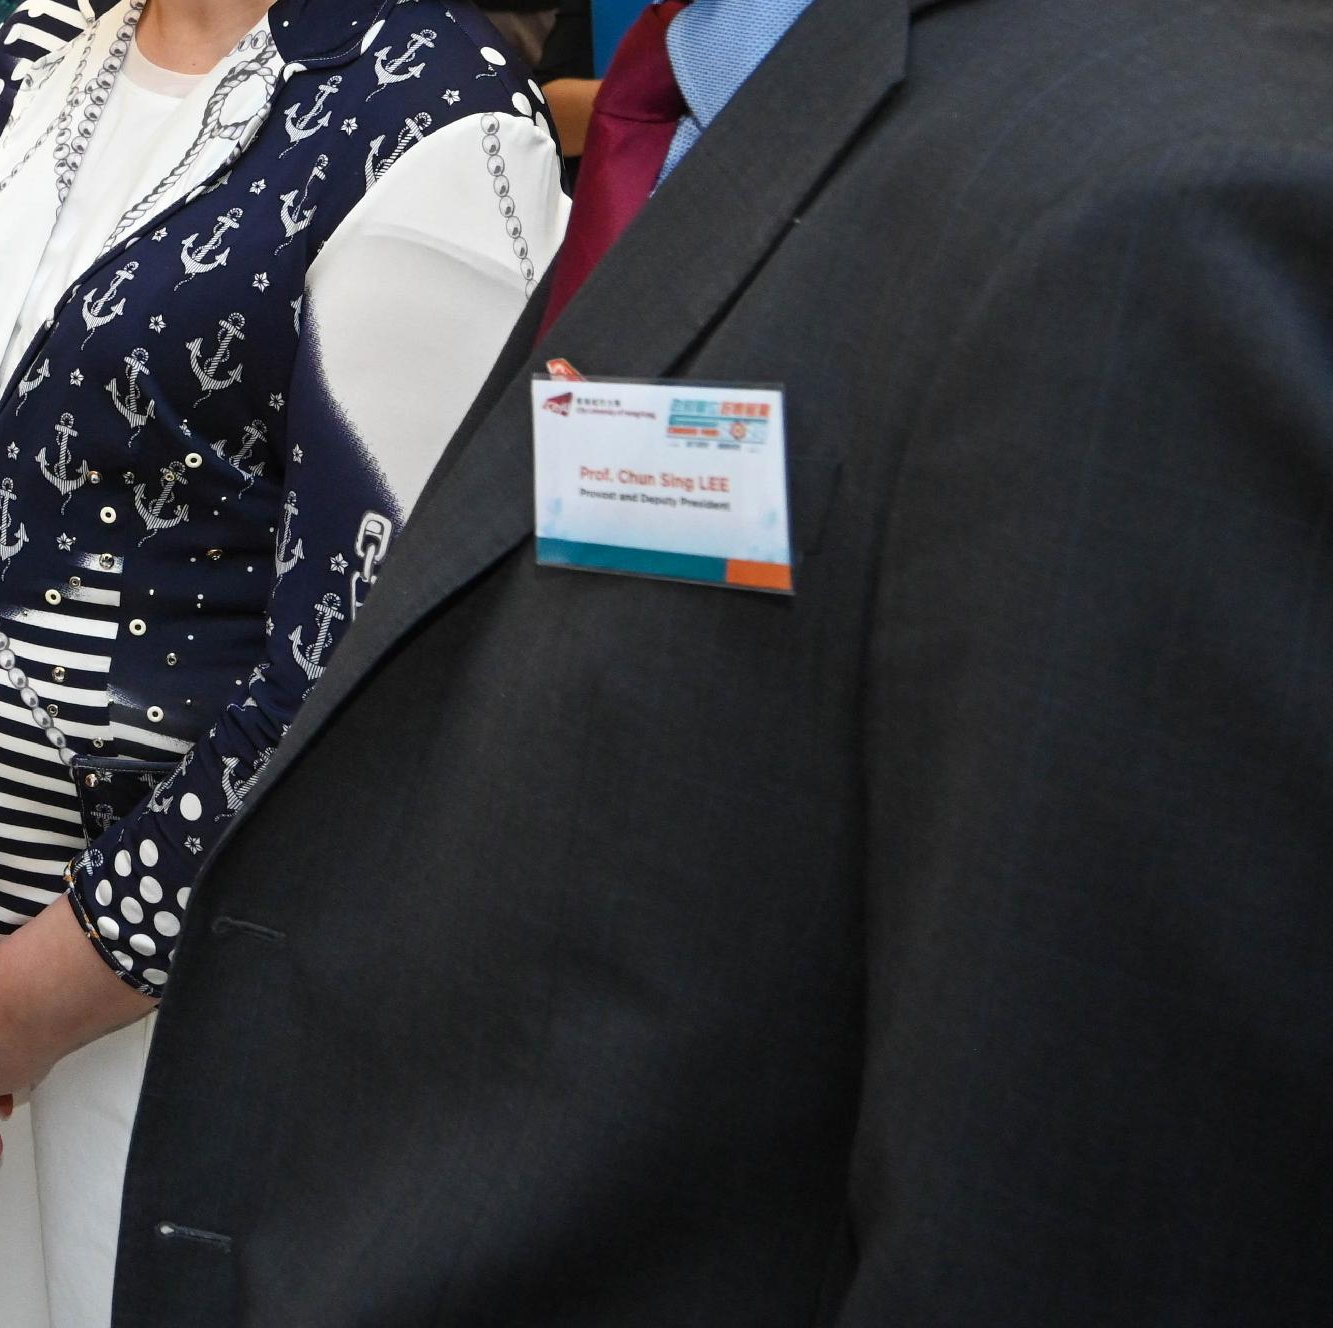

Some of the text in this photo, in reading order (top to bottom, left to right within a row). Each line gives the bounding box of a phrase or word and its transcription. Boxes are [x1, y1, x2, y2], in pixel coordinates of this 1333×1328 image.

[580, 465, 613, 482] Prof.
[660, 473, 694, 493] Sing
[699, 476, 730, 493] LEE
[580, 488, 732, 511] Provost and Deputy President
